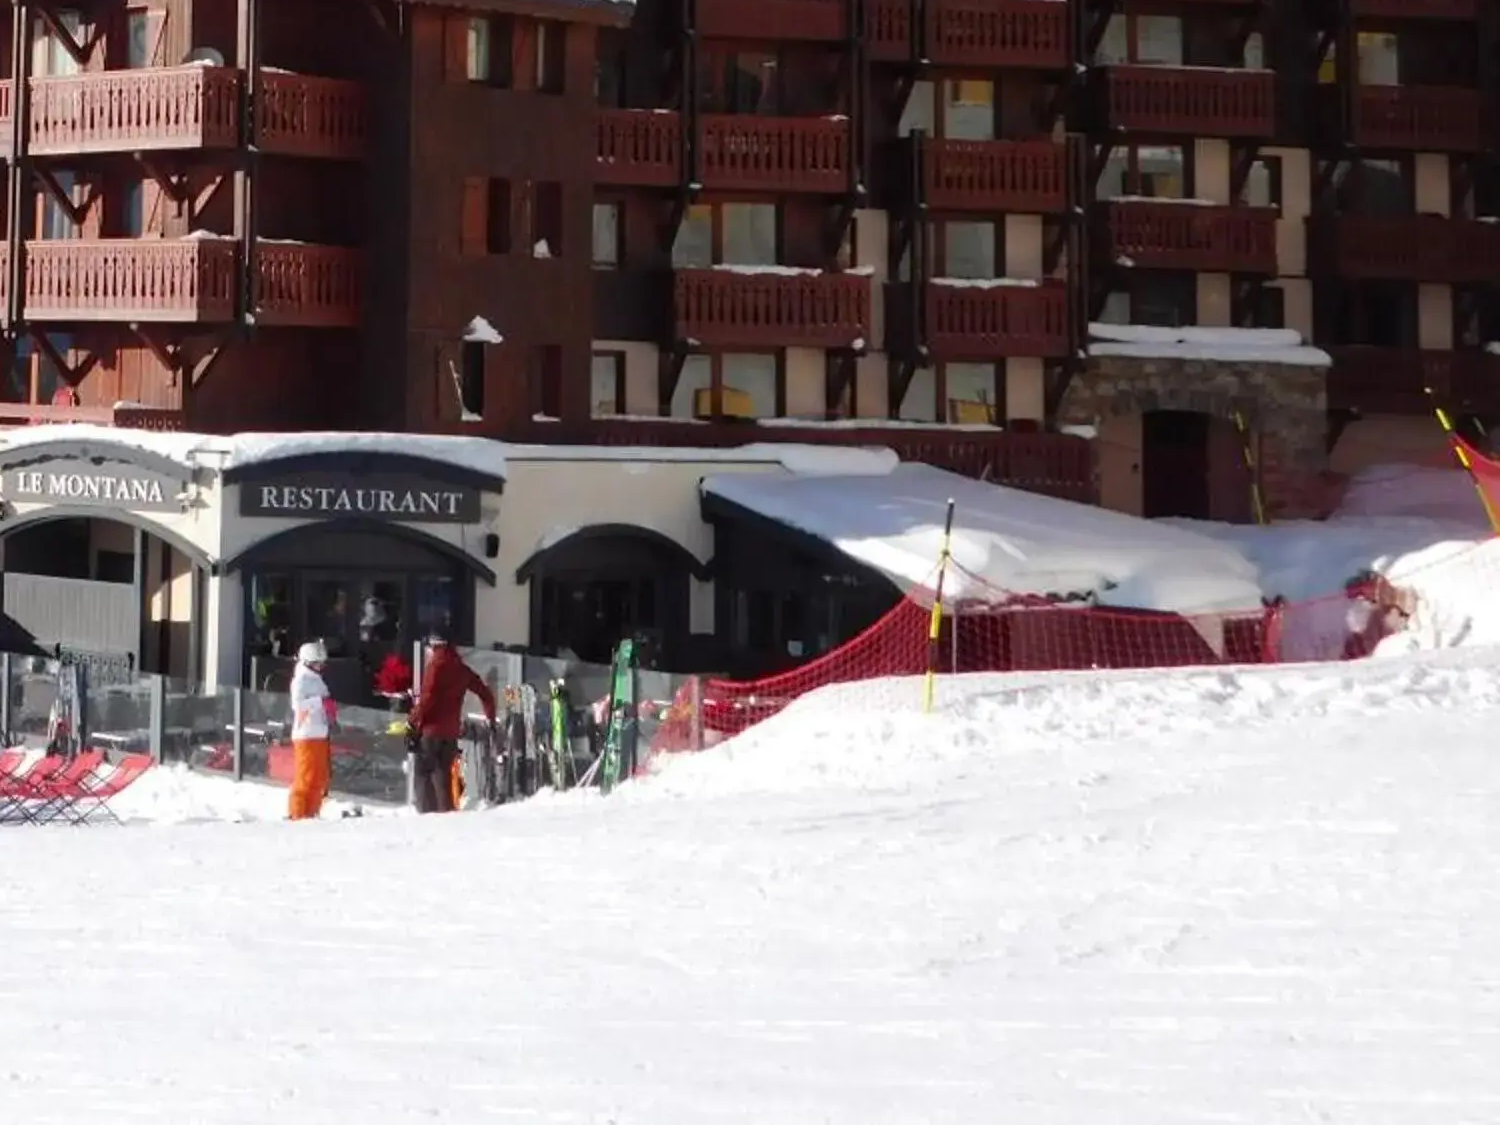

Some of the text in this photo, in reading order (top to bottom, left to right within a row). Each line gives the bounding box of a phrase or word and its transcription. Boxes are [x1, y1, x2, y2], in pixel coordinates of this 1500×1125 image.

[17, 472, 164, 503] LE MONTANA
[259, 486, 464, 515] RESTAURANT
